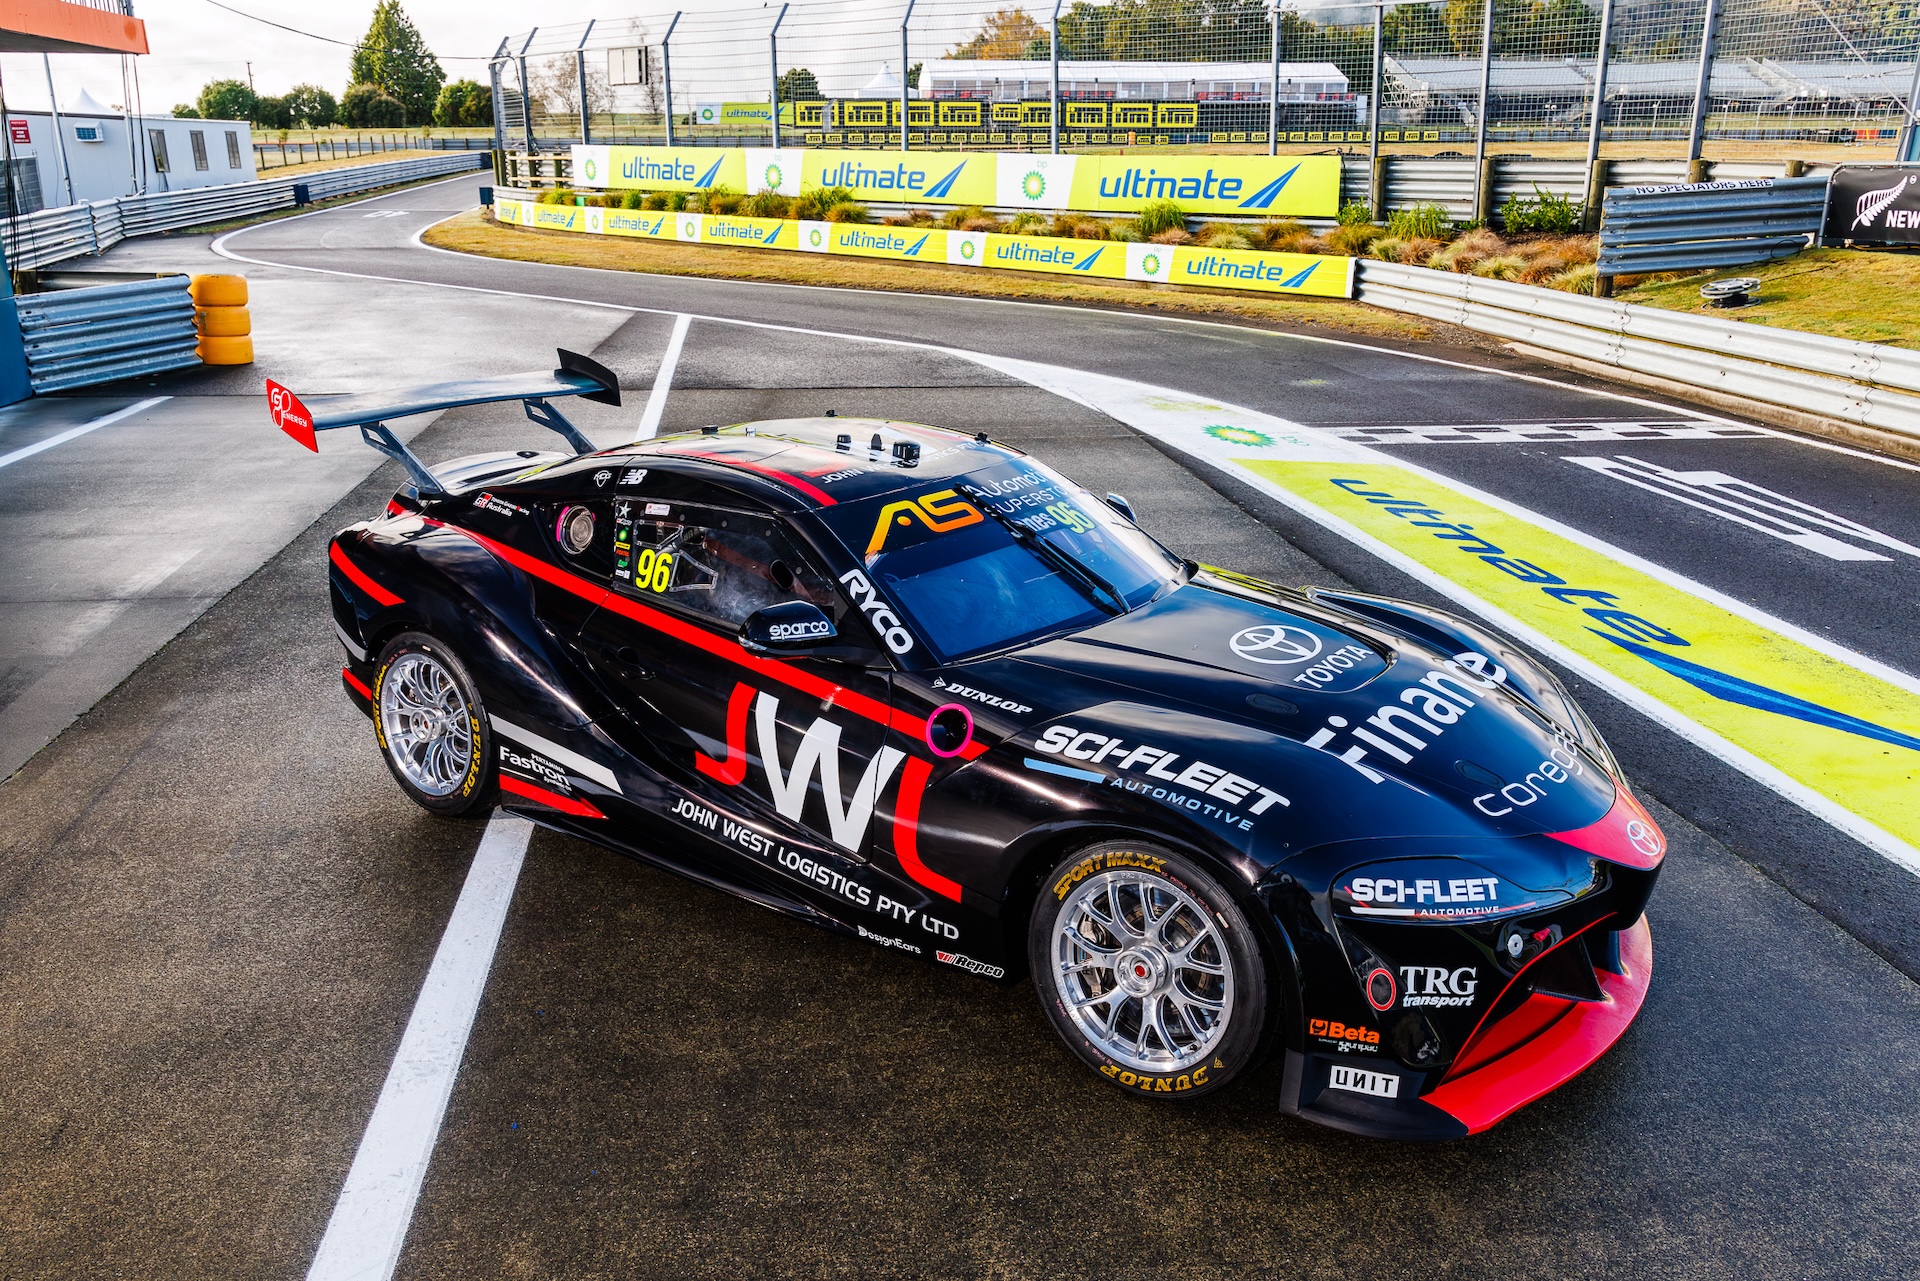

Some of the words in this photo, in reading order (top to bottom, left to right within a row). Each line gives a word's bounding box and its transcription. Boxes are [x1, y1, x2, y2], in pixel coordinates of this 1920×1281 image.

[726, 108, 769, 118] ultimate
[622, 154, 695, 181] ultimate
[822, 161, 926, 190] ultimate
[1036, 159, 1048, 169] bp
[1099, 168, 1243, 200] ultimate
[1636, 185, 1656, 195] NO
[1660, 181, 1737, 193] SPECTATORS
[1740, 179, 1773, 188] HERE
[537, 210, 567, 225] ultimate
[608, 215, 650, 231] ultimate
[709, 221, 764, 240] ultimate
[1885, 210, 1920, 229] NEW
[839, 230, 905, 251] ultimate
[996, 242, 1076, 265] ultimate
[1186, 256, 1284, 282] ultimate
[821, 468, 864, 484] JOHN
[865, 489, 985, 556] AS
[1045, 501, 1097, 535] 96
[634, 548, 674, 593] 96
[1328, 478, 1692, 647] ultimate
[839, 568, 914, 654] RYCO
[769, 620, 829, 640] sparco
[1293, 644, 1374, 689] TOYOTA
[944, 682, 1034, 714] DUNLOP
[462, 714, 481, 798] DUNLOP
[500, 745, 570, 787] Fastron
[1034, 724, 1292, 817] SCI-FLEET
[1110, 776, 1255, 832] AUTOMOTIVE
[671, 798, 719, 831] JOHN
[722, 818, 775, 857] WEST
[777, 846, 872, 906] LOGISTICS
[876, 894, 917, 924] PTY
[921, 913, 960, 941] LTD
[1052, 853, 1104, 901] SPORT
[1106, 851, 1167, 873] MAXX
[1351, 877, 1499, 903] SCI-FLEET
[1419, 905, 1500, 917] AUTOMOTIVE
[954, 953, 1005, 979] Repco
[1400, 965, 1479, 996] TRG
[1402, 994, 1476, 1010] transport
[1328, 1021, 1381, 1044] Beta
[1099, 1064, 1209, 1092] DUNLOP
[1335, 1069, 1394, 1093] UNIT
